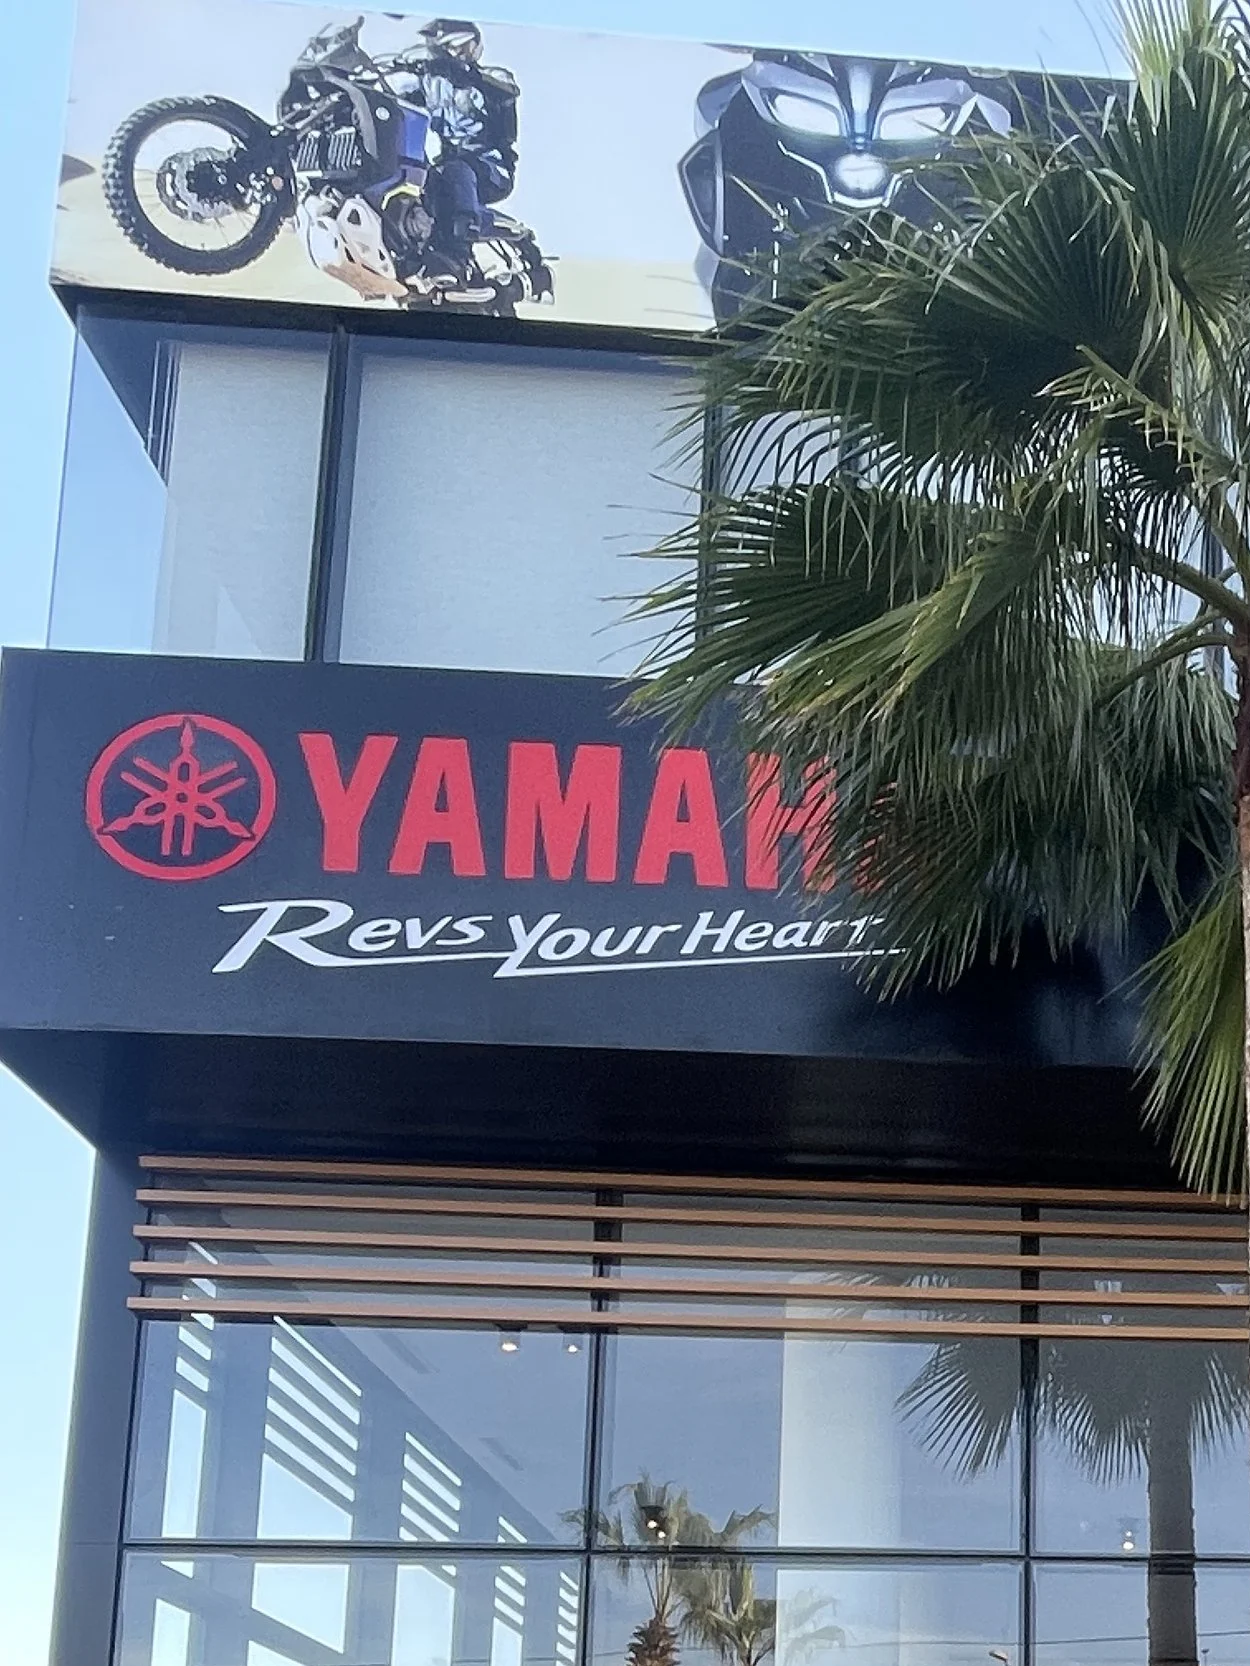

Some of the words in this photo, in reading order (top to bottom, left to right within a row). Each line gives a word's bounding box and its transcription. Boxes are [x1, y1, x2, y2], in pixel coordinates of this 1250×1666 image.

[298, 731, 898, 894] YAMAH
[212, 898, 496, 974] Revs
[494, 911, 682, 979] Your
[680, 909, 886, 955] Heart
